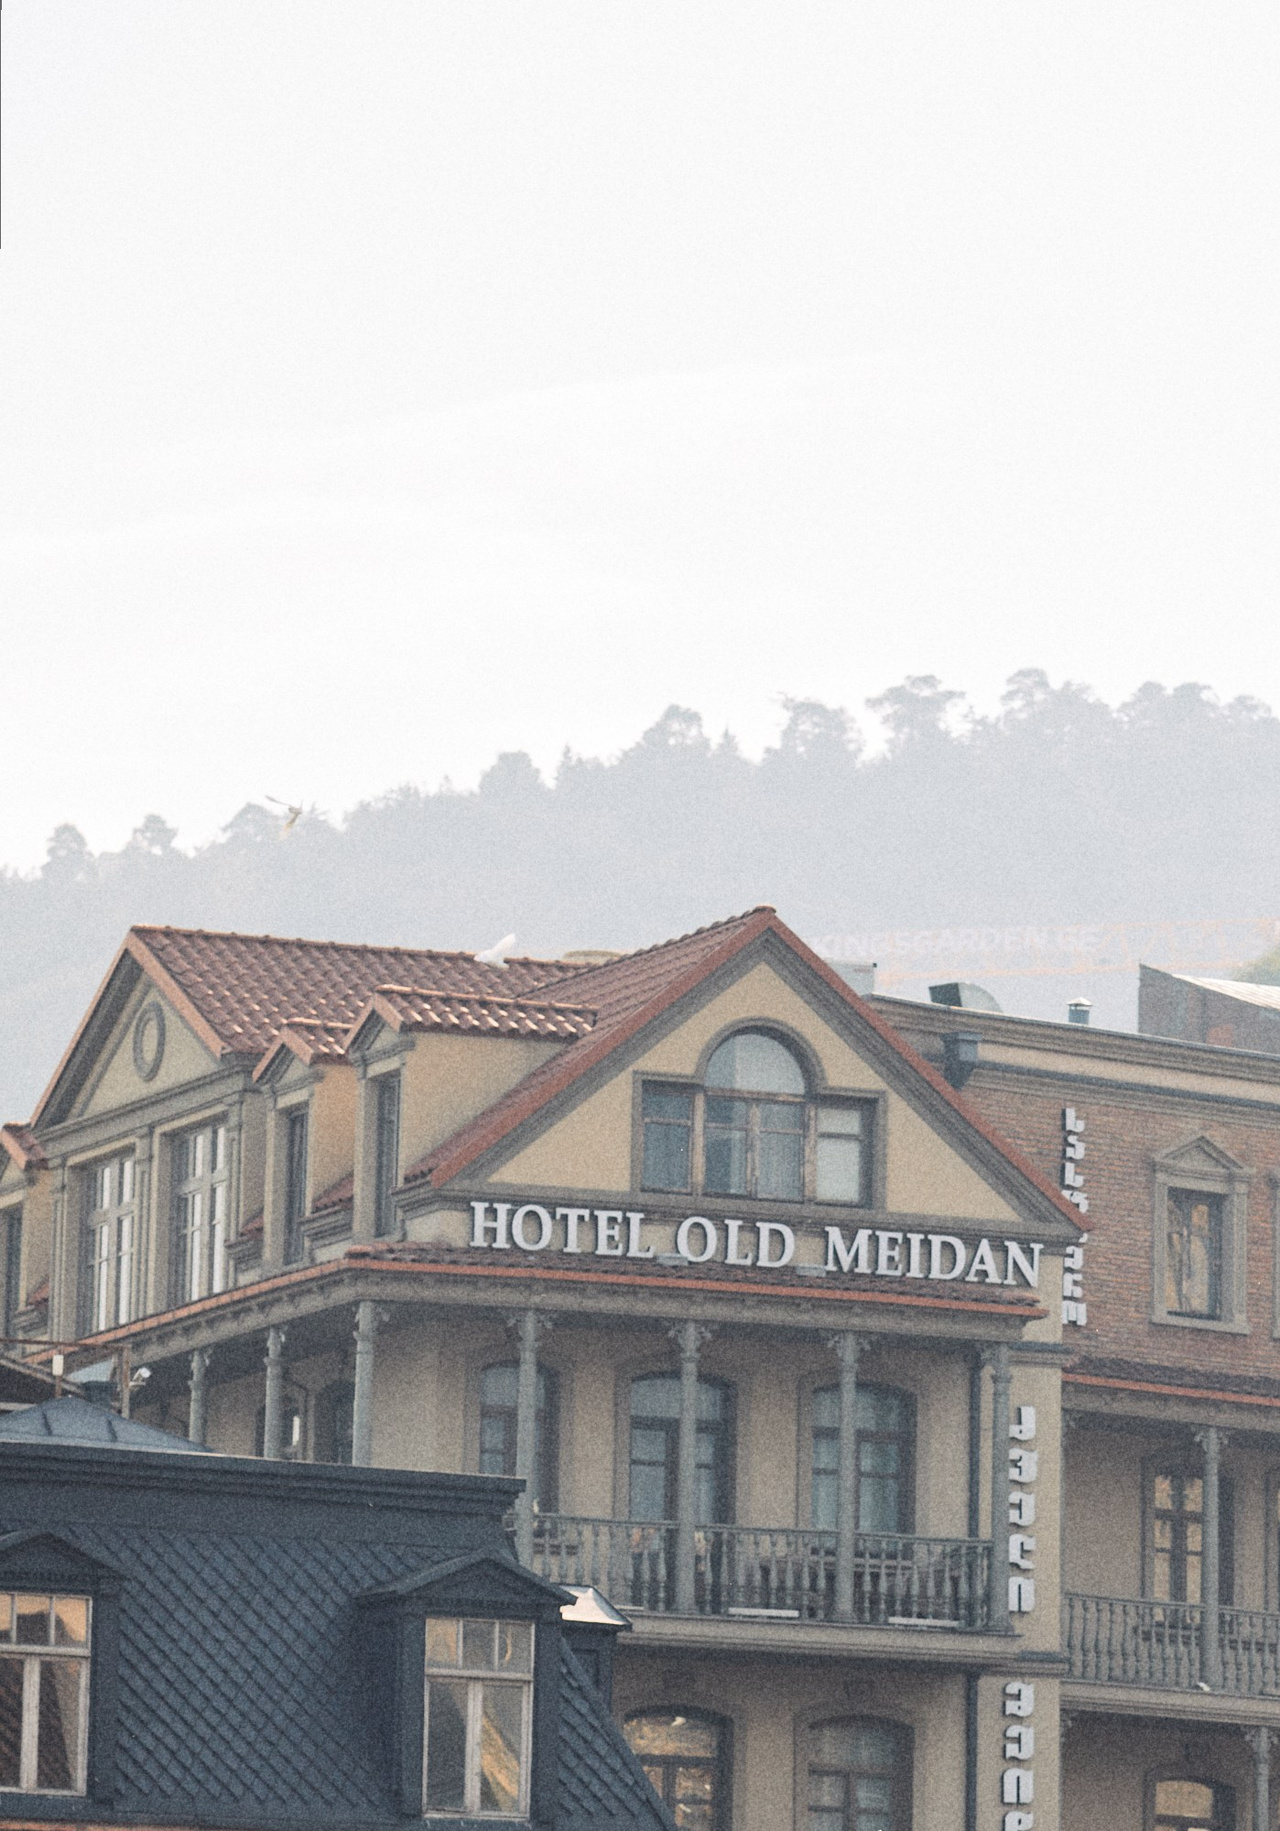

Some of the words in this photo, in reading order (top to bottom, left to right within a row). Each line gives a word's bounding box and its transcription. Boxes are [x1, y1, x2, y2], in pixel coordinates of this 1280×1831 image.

[470, 1200, 655, 1260] HOTEL
[676, 1215, 796, 1268] OLD
[825, 1226, 1044, 1288] MEIDAN
[1008, 1406, 1038, 1613] ძველი
